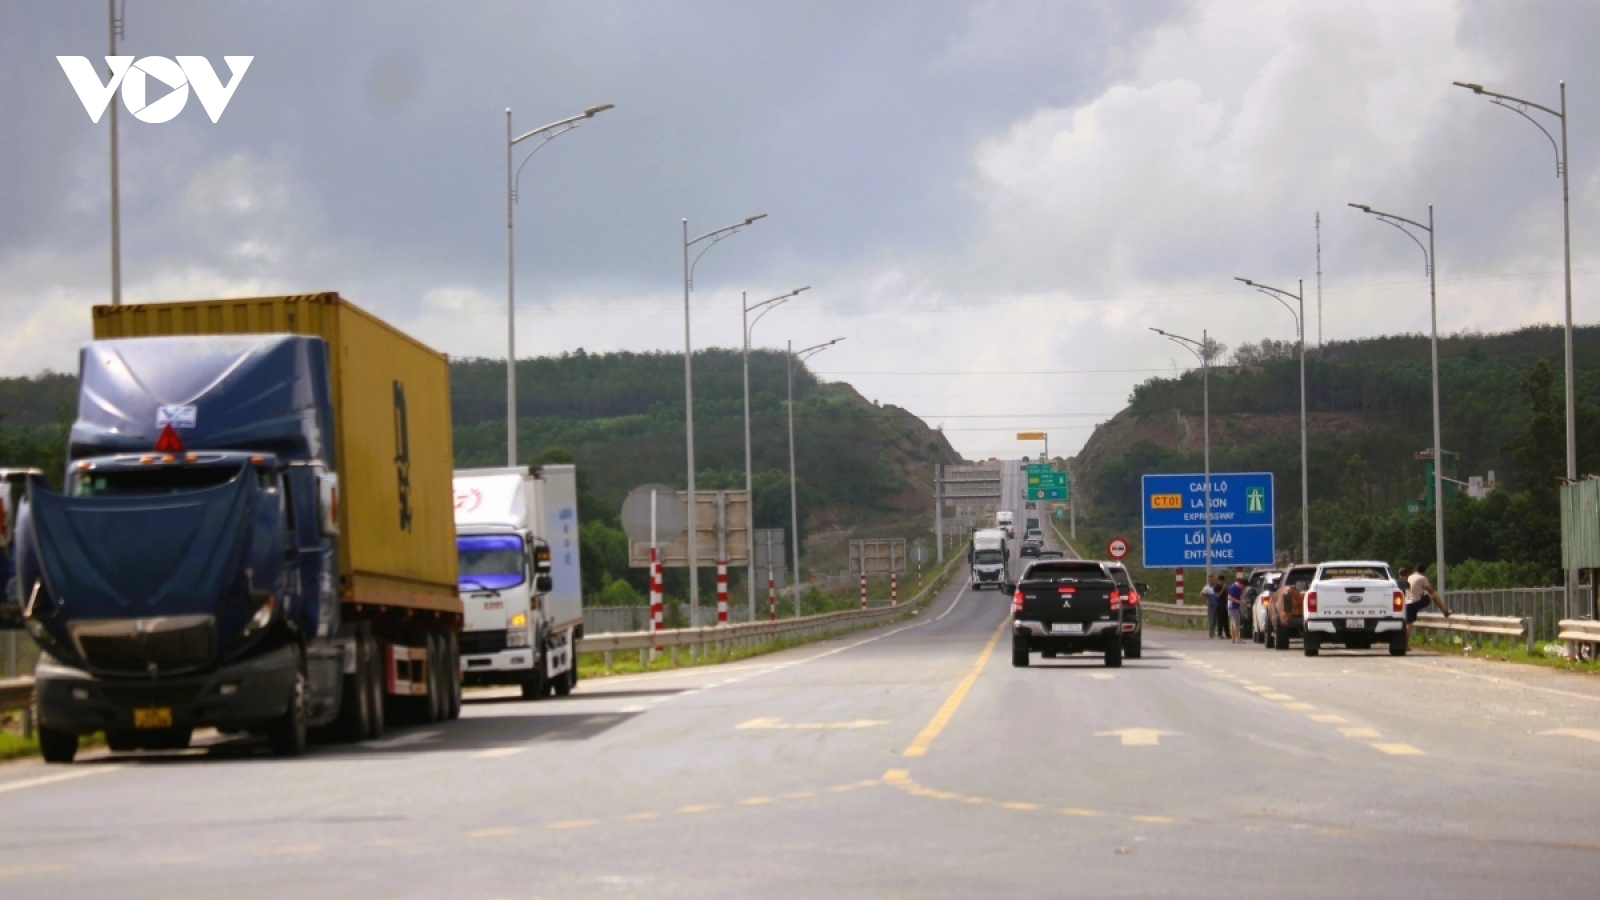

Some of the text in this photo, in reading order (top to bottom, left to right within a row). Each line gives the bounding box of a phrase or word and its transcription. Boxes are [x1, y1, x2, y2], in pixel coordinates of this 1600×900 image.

[1214, 480, 1228, 494] LỘ
[1190, 498, 1204, 509] LA
[1183, 511, 1235, 521] EXPRSSWAY
[1184, 530, 1205, 545] LỐI
